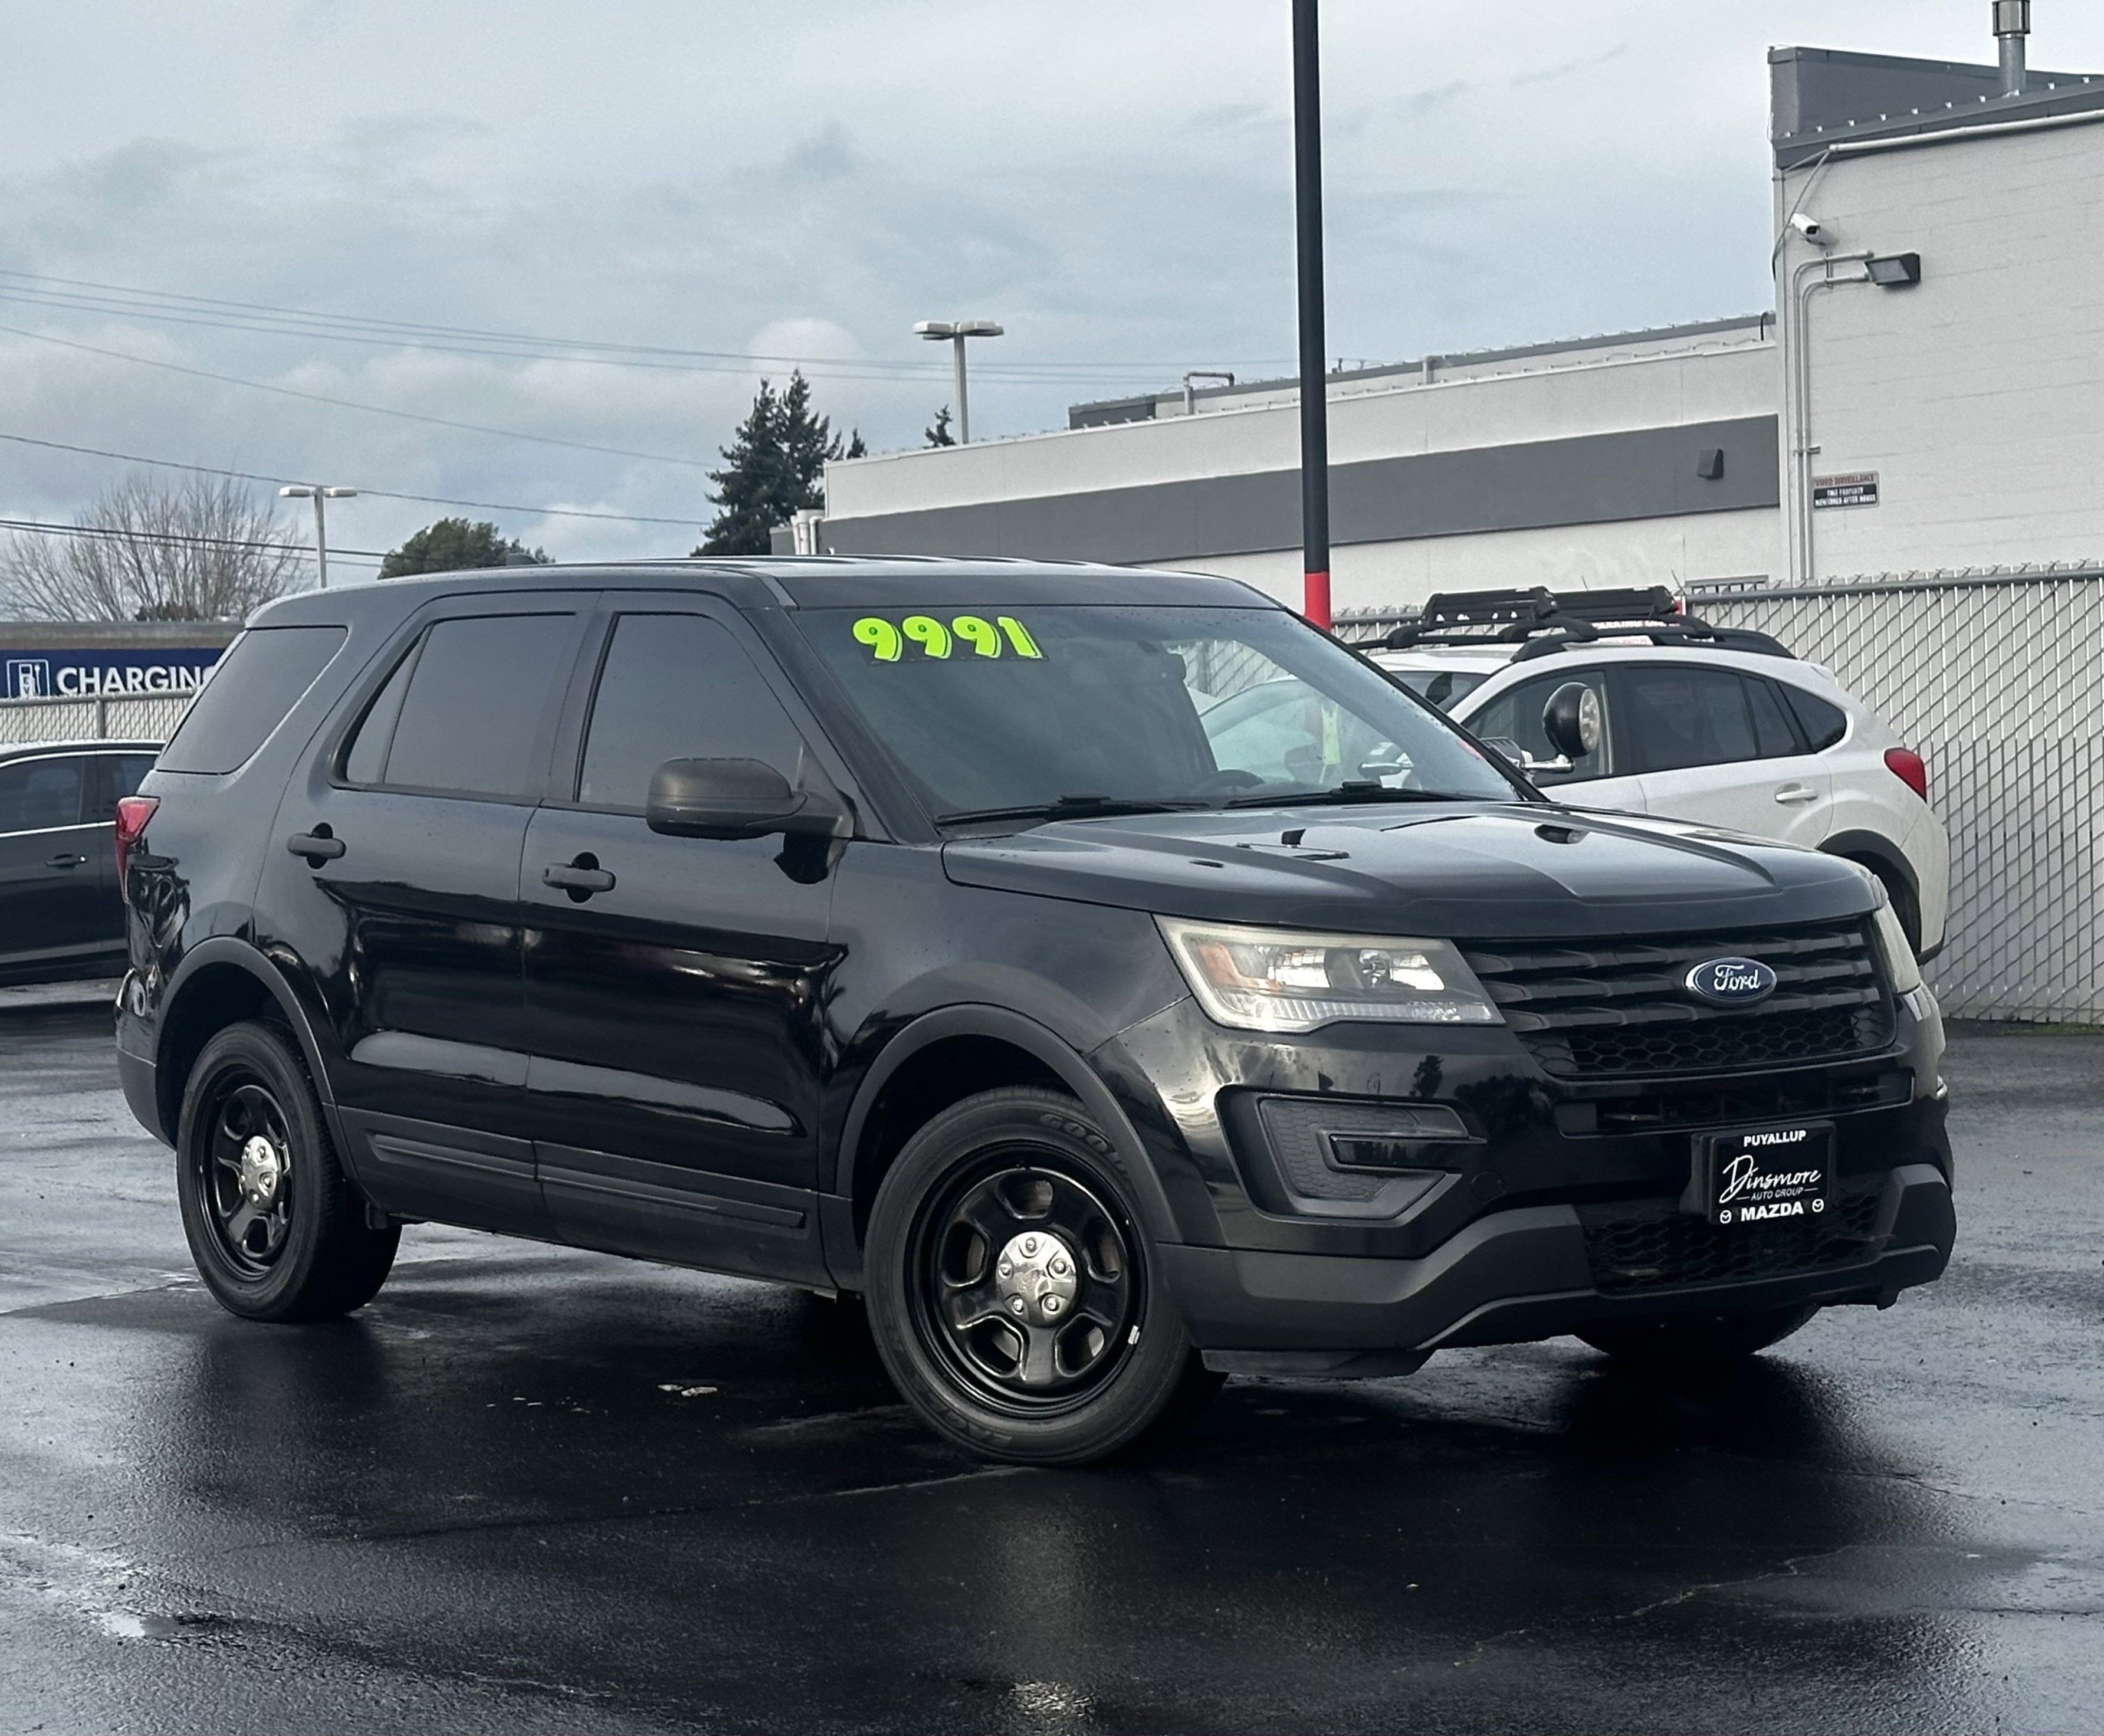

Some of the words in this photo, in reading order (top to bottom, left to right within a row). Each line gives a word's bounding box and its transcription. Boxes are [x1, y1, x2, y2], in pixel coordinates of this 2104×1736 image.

[853, 616, 1042, 661] 9991
[1714, 964, 1761, 990] Ford
[1744, 1130, 1806, 1147] PUYALLUP
[1719, 1155, 1821, 1203] Dinsmore
[1751, 1190, 1773, 1201] AUTO
[1775, 1187, 1804, 1198] GROUP
[1741, 1201, 1804, 1222] MAZDA
